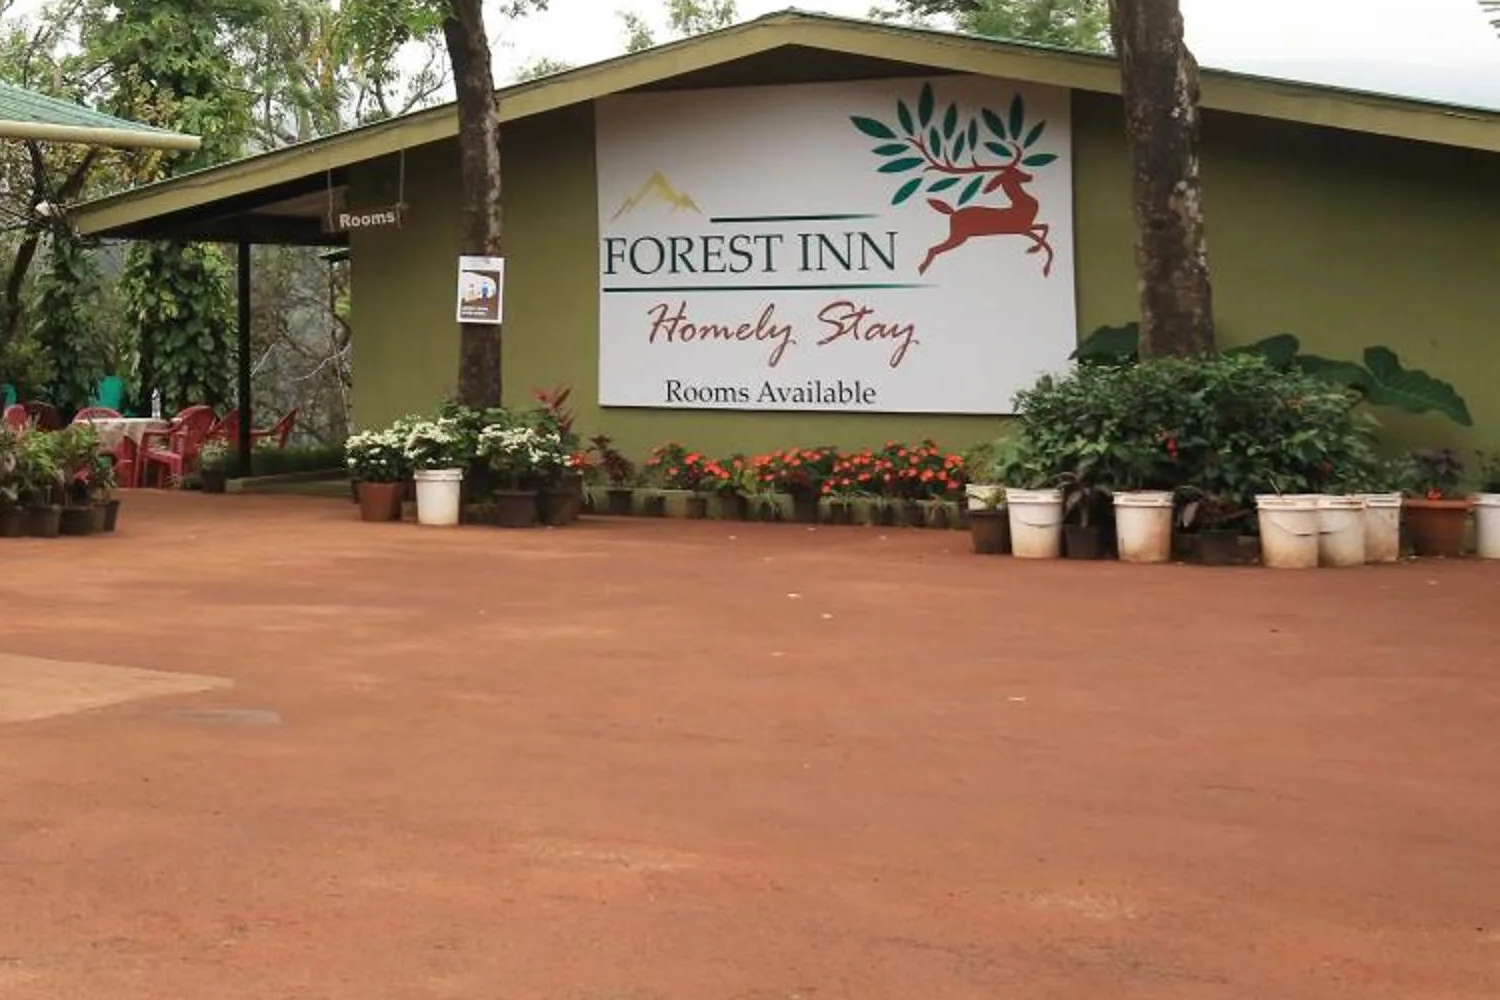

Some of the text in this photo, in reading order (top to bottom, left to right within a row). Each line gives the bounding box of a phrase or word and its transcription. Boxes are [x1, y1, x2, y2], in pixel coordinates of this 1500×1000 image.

[339, 211, 395, 229] Rooms
[603, 231, 899, 275] FOREST INN
[647, 300, 920, 369] Homely Stay
[665, 379, 877, 405] Rooms Available
